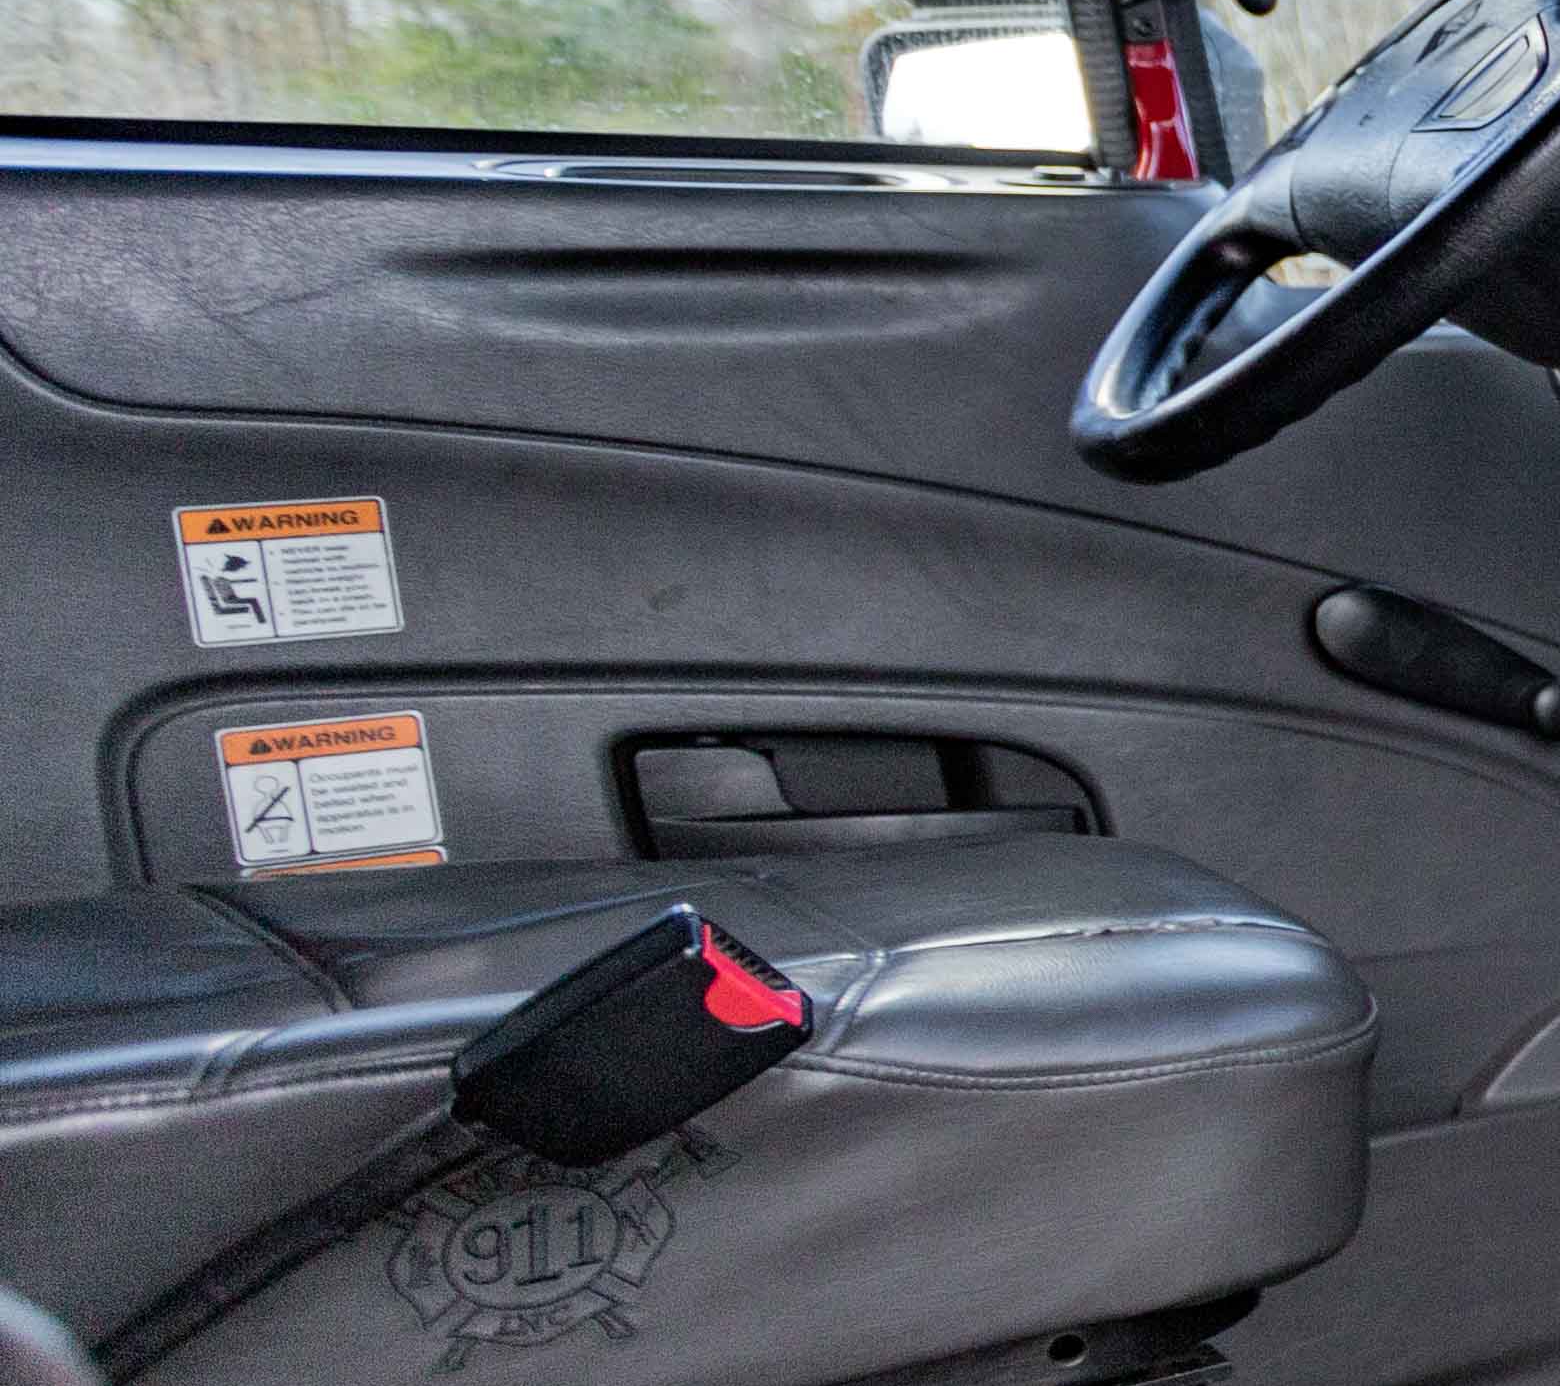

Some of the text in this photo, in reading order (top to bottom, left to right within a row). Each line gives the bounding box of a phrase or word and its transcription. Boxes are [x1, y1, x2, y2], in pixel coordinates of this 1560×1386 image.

[231, 510, 360, 532] WARNING
[271, 725, 397, 751] WARNING
[462, 1203, 604, 1287] 911
